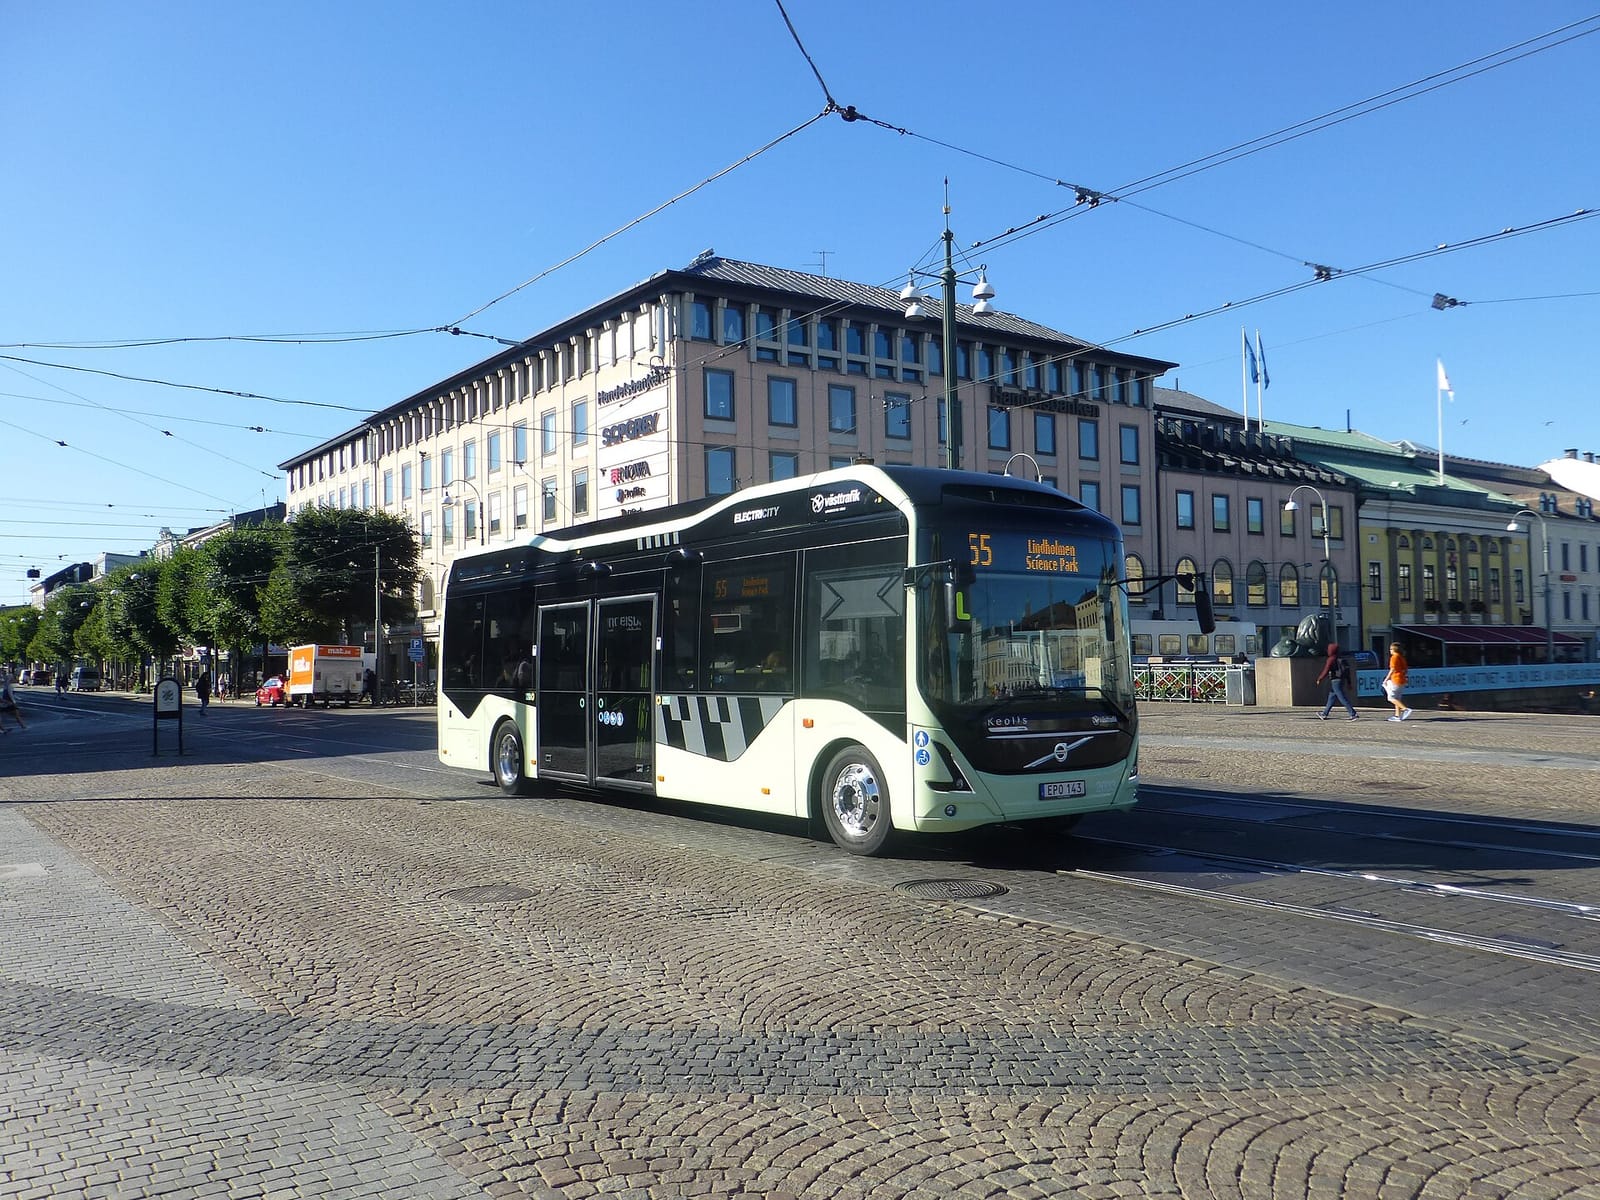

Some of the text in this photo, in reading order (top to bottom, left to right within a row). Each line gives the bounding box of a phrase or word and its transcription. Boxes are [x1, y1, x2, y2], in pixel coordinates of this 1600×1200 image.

[989, 384, 1100, 418] Handelsbanken
[824, 489, 860, 506] västtrafik
[733, 506, 780, 524] ELECTRICITY
[968, 533, 993, 566] 55
[1027, 539, 1076, 556] Lindholmen
[1025, 556, 1079, 572] Science Park
[987, 716, 1029, 727] Keolis
[1047, 783, 1082, 796] EPO 143
